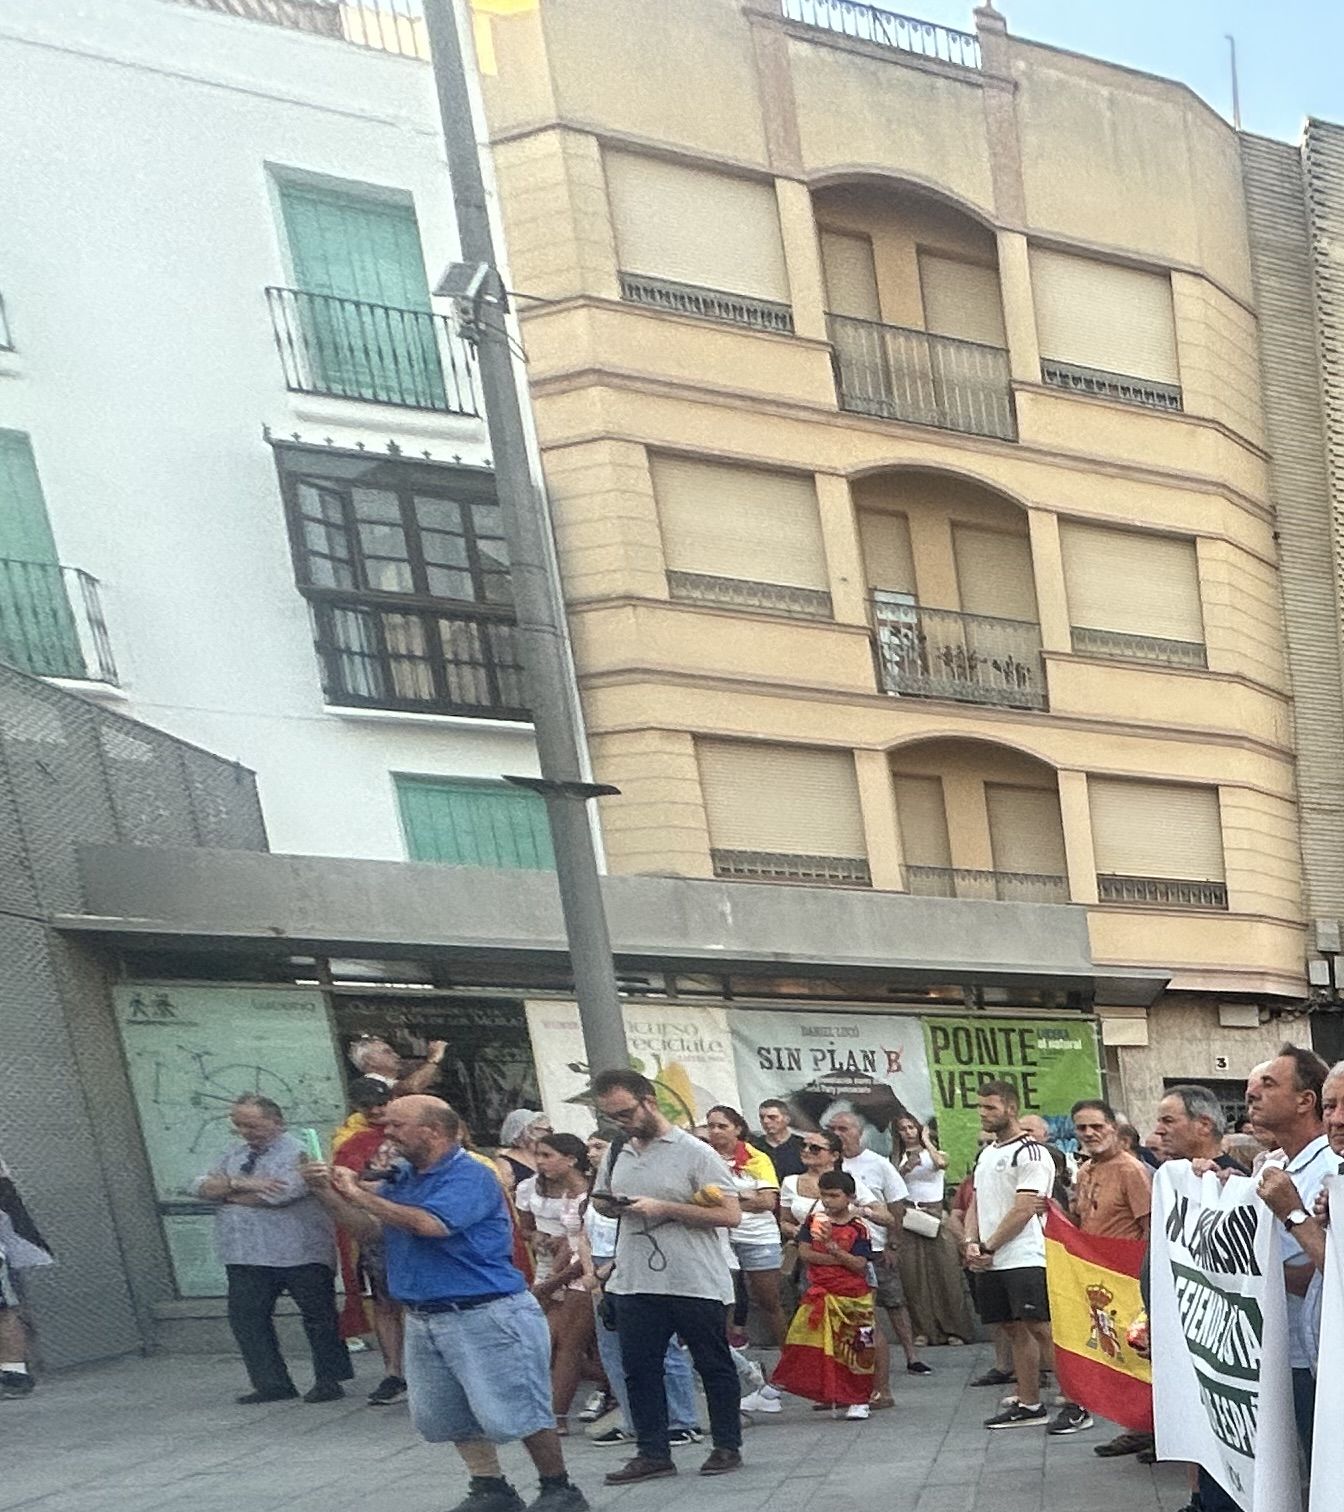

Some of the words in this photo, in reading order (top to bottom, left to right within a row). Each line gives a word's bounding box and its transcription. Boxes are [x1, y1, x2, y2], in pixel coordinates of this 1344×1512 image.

[757, 1046, 802, 1071] SIN
[808, 1048, 877, 1073] PLAN
[930, 1025, 1038, 1067] PONTE
[1216, 1057, 1227, 1069] 3
